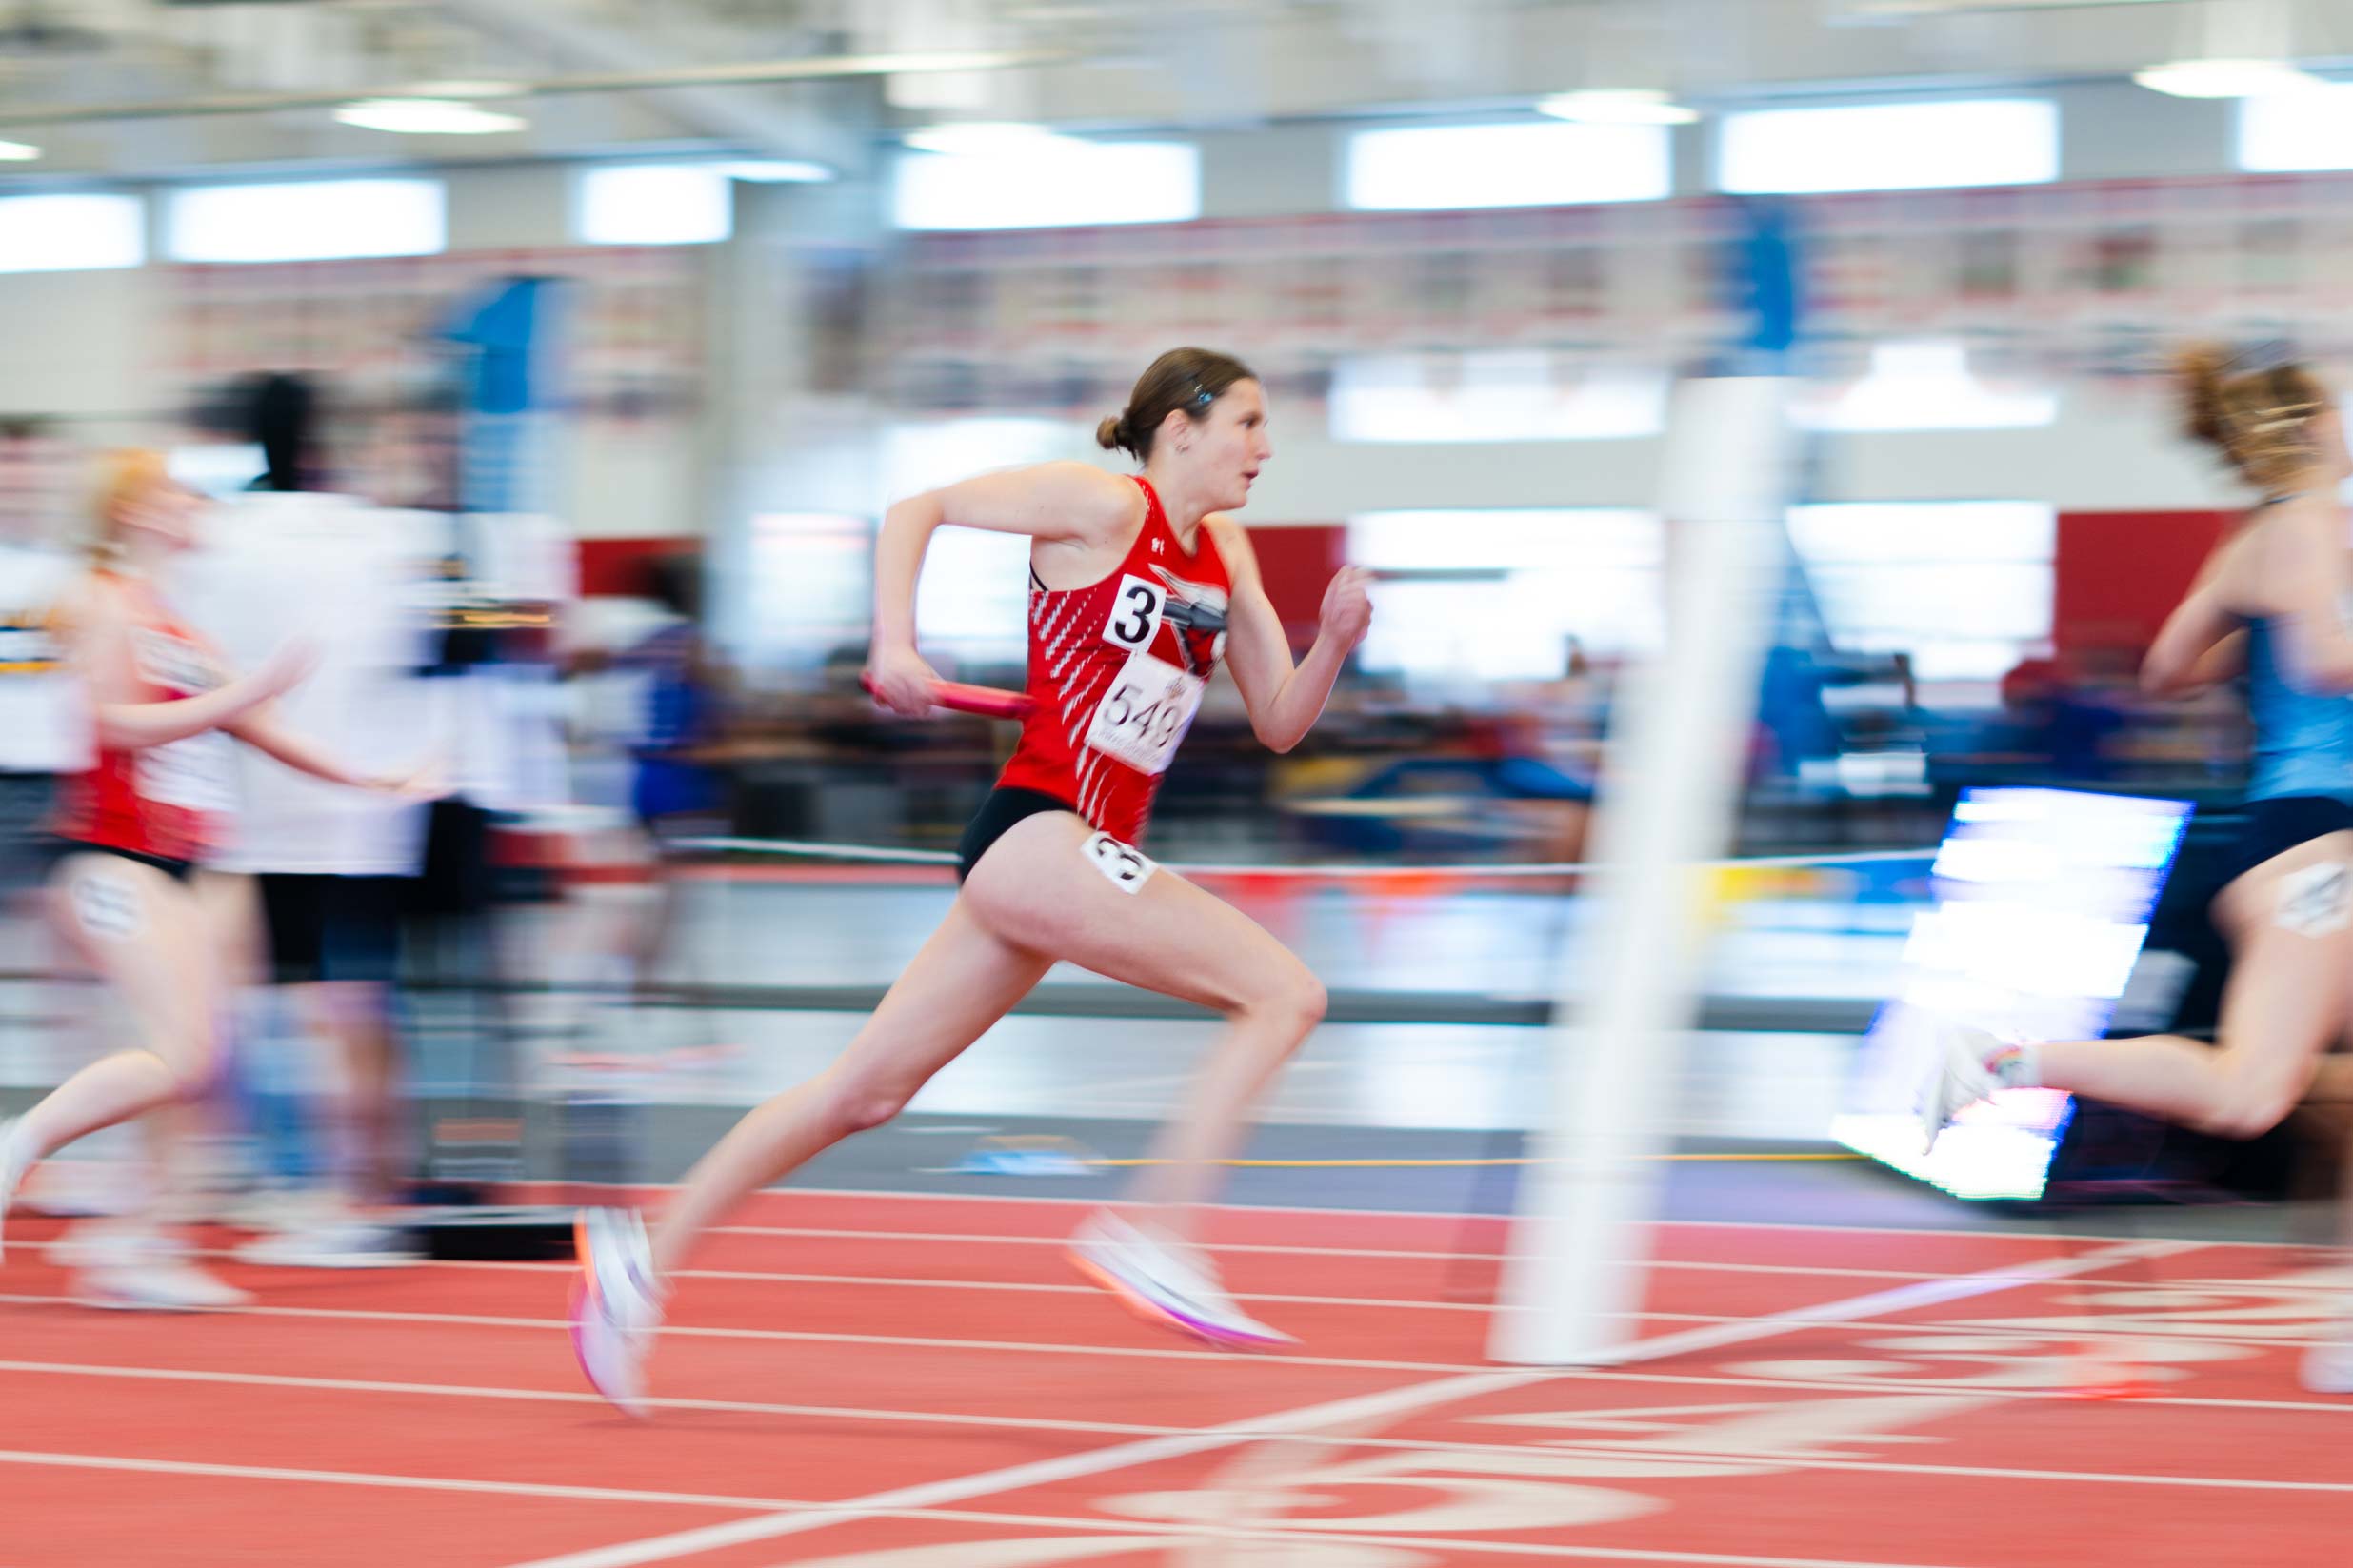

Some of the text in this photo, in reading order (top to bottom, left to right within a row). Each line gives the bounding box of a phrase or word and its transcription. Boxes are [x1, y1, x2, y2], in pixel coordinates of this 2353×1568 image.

[1114, 586, 1156, 643] 3
[1096, 837, 1143, 881] 3
[1710, 1335, 2268, 1387] 3
[1456, 1395, 2007, 1459] 4
[1089, 1450, 1805, 1532] 5
